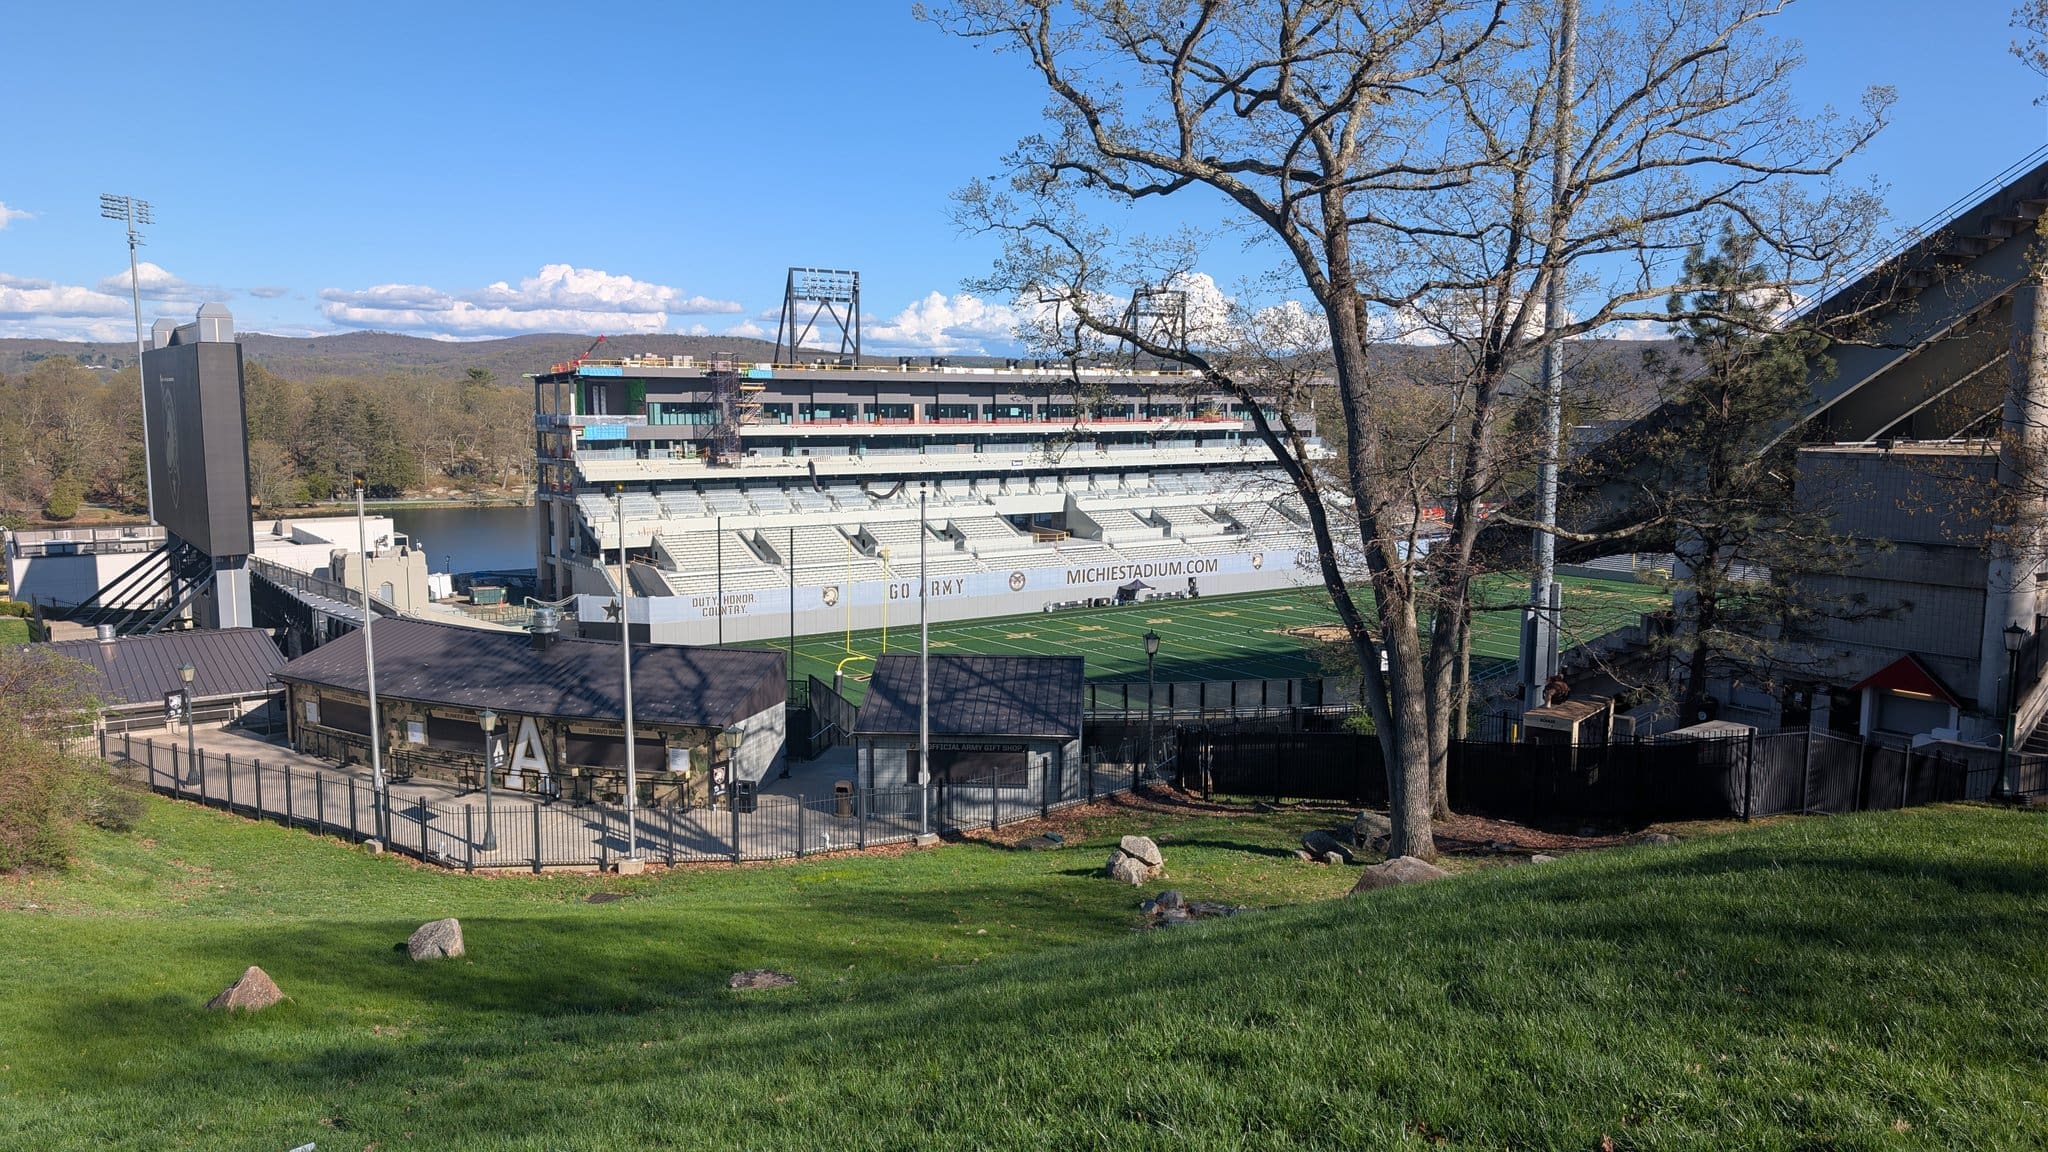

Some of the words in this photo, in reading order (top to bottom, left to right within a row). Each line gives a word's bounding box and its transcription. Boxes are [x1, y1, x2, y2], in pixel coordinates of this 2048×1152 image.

[1067, 559, 1217, 584] MICHIESTADIUM.COM
[889, 583, 910, 600] GO
[961, 744, 982, 752] ARMY
[984, 744, 1001, 752] GIFT
